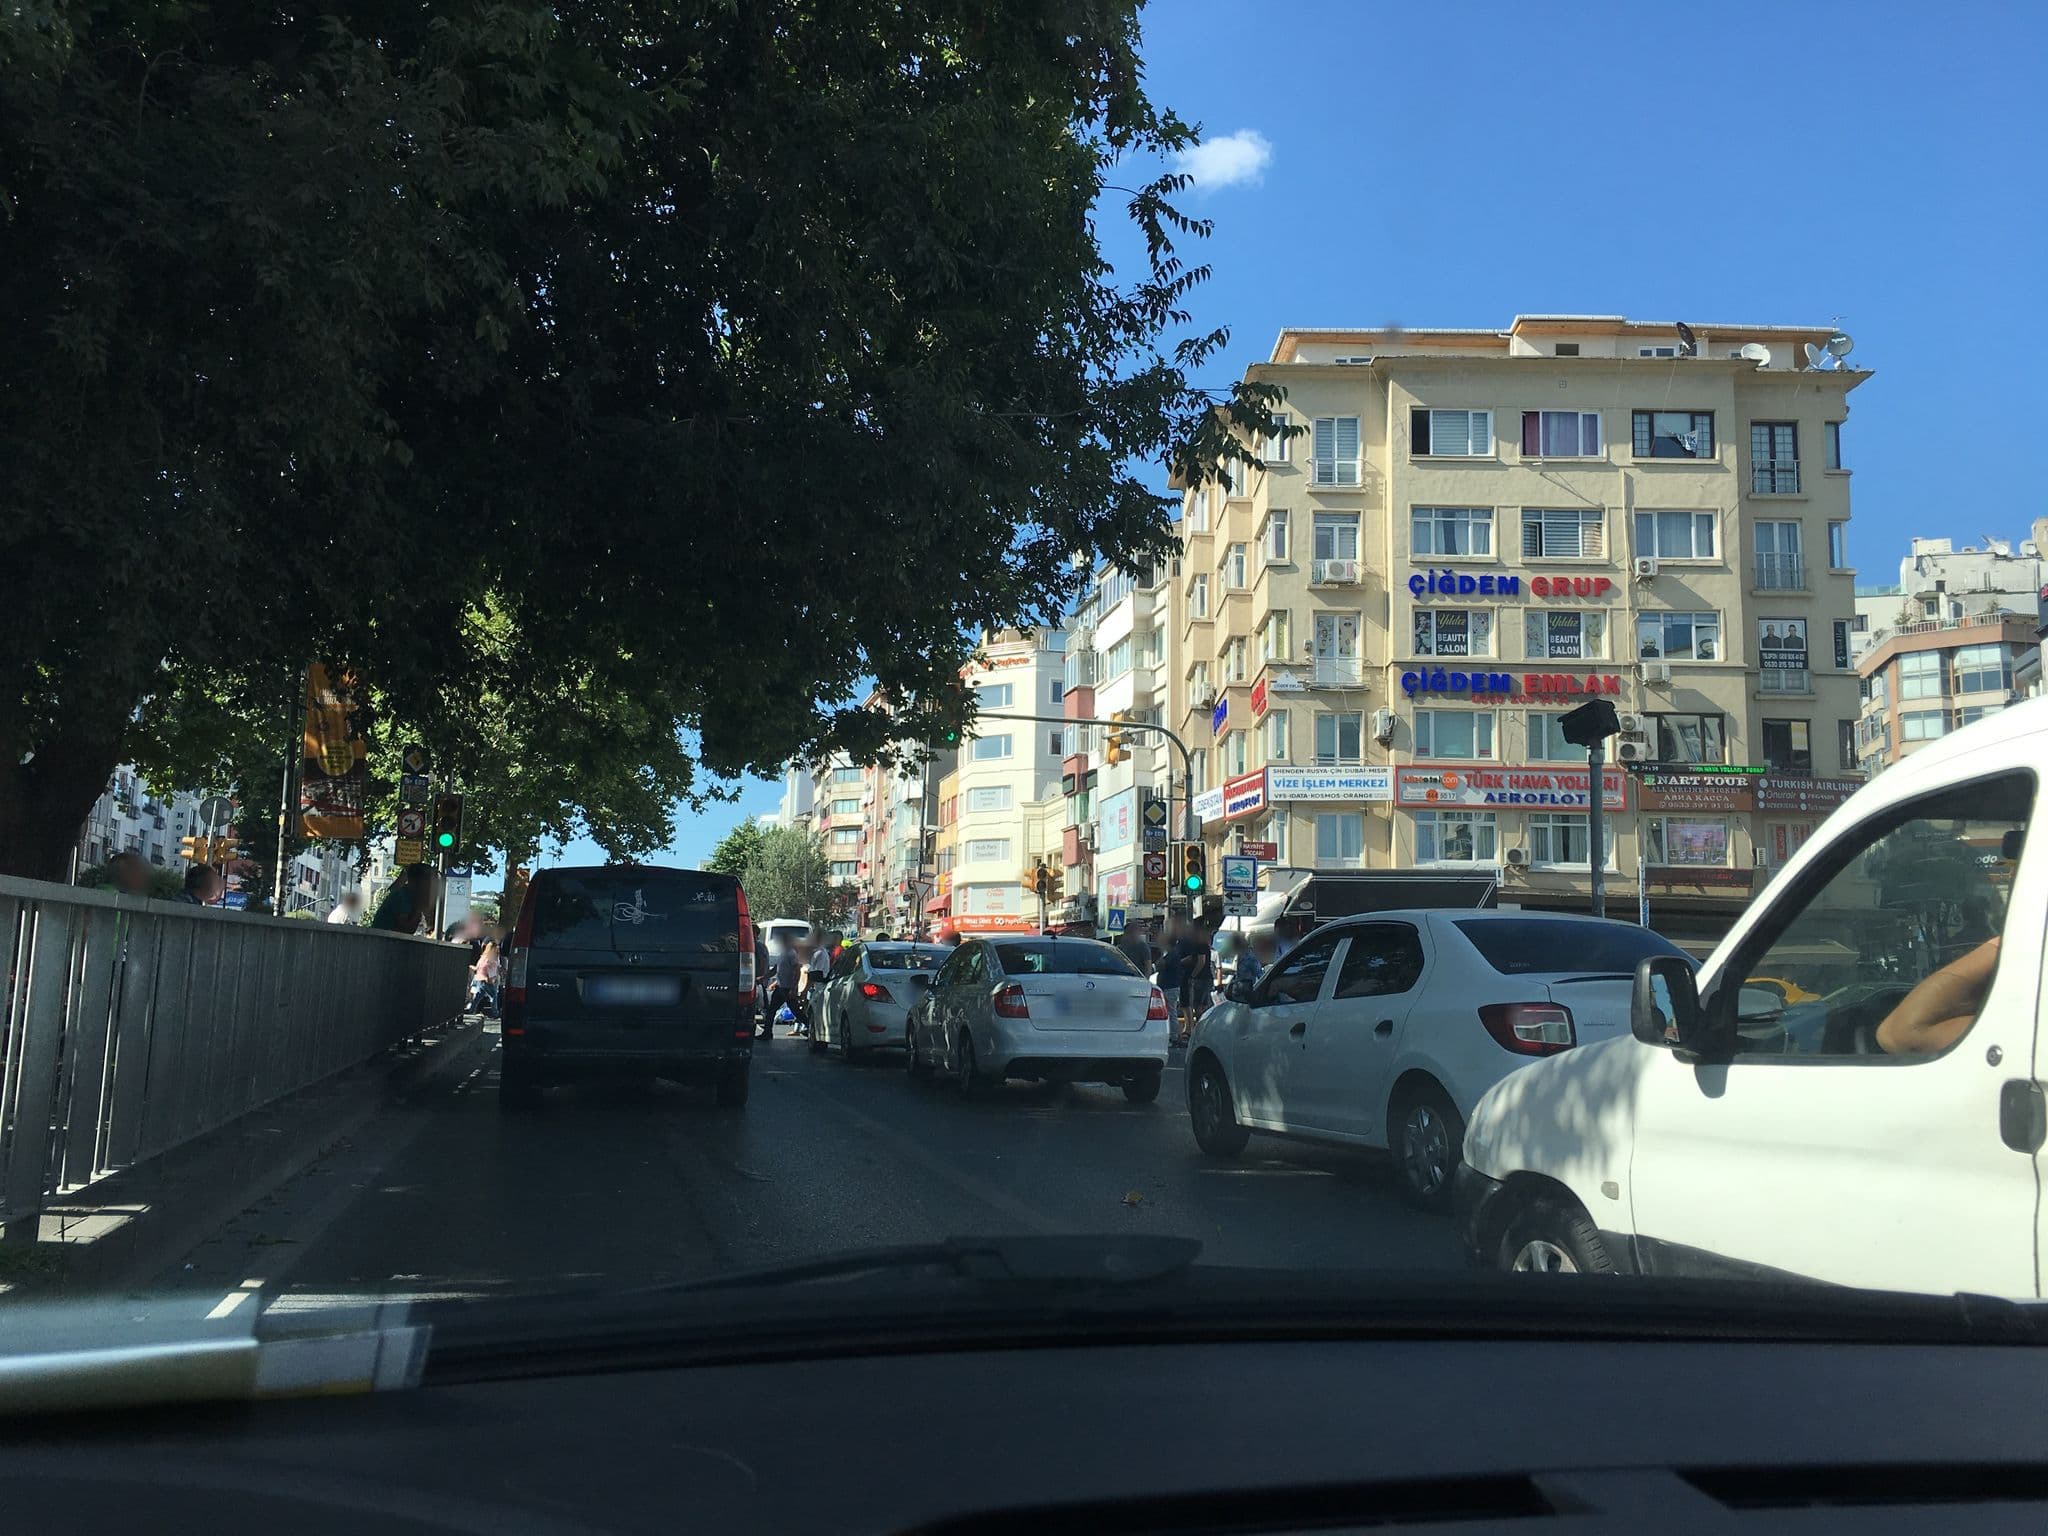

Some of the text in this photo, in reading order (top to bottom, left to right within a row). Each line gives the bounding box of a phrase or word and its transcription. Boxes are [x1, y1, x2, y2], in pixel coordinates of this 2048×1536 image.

[1408, 569, 1612, 598] ÇİĞDEM GRUP
[1438, 633, 1467, 643] BEAUTY
[1550, 634, 1579, 644] BEAUTY
[1438, 643, 1467, 653] SALON
[1550, 645, 1579, 655] SALON
[1401, 667, 1621, 697] ÇİĞDEM EMLAK
[1274, 777, 1299, 788] VİZE
[1302, 777, 1335, 790] İŞLEM
[1338, 776, 1388, 788] MERKEZİ
[1465, 771, 1619, 791] TÜRK HAVA YOLLRI
[1657, 775, 1749, 786] NART TOUR
[1770, 780, 1861, 792] TURKISH AIRLINES
[1484, 793, 1586, 805] AEROFLOT
